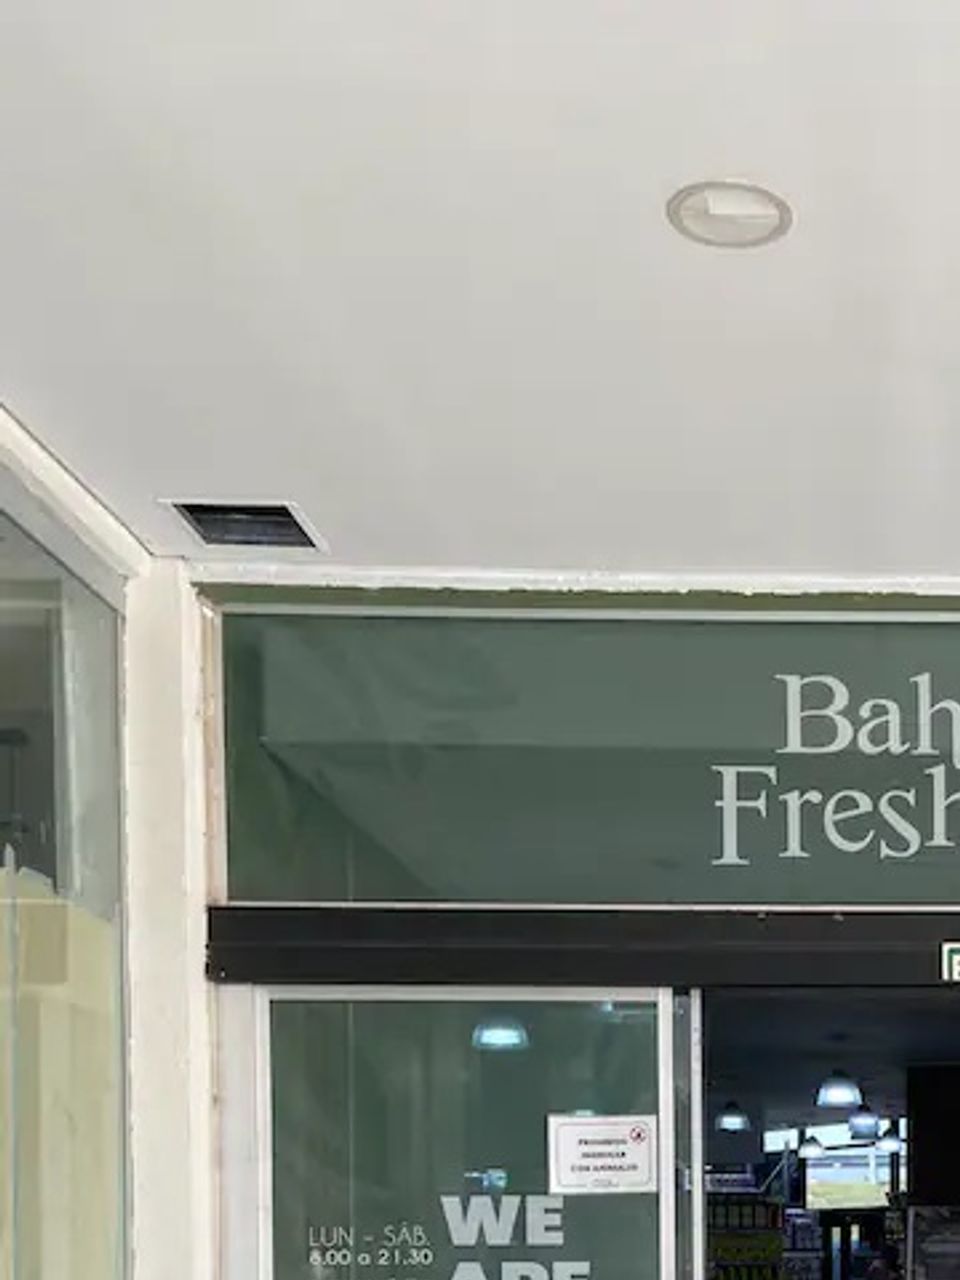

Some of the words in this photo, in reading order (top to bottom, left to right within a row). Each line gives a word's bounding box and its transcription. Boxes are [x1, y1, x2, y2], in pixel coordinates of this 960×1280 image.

[440, 1195, 564, 1246] WE
[309, 1226, 354, 1247] LUN
[357, 1252, 371, 1265] a
[377, 1249, 434, 1265] 21.30
